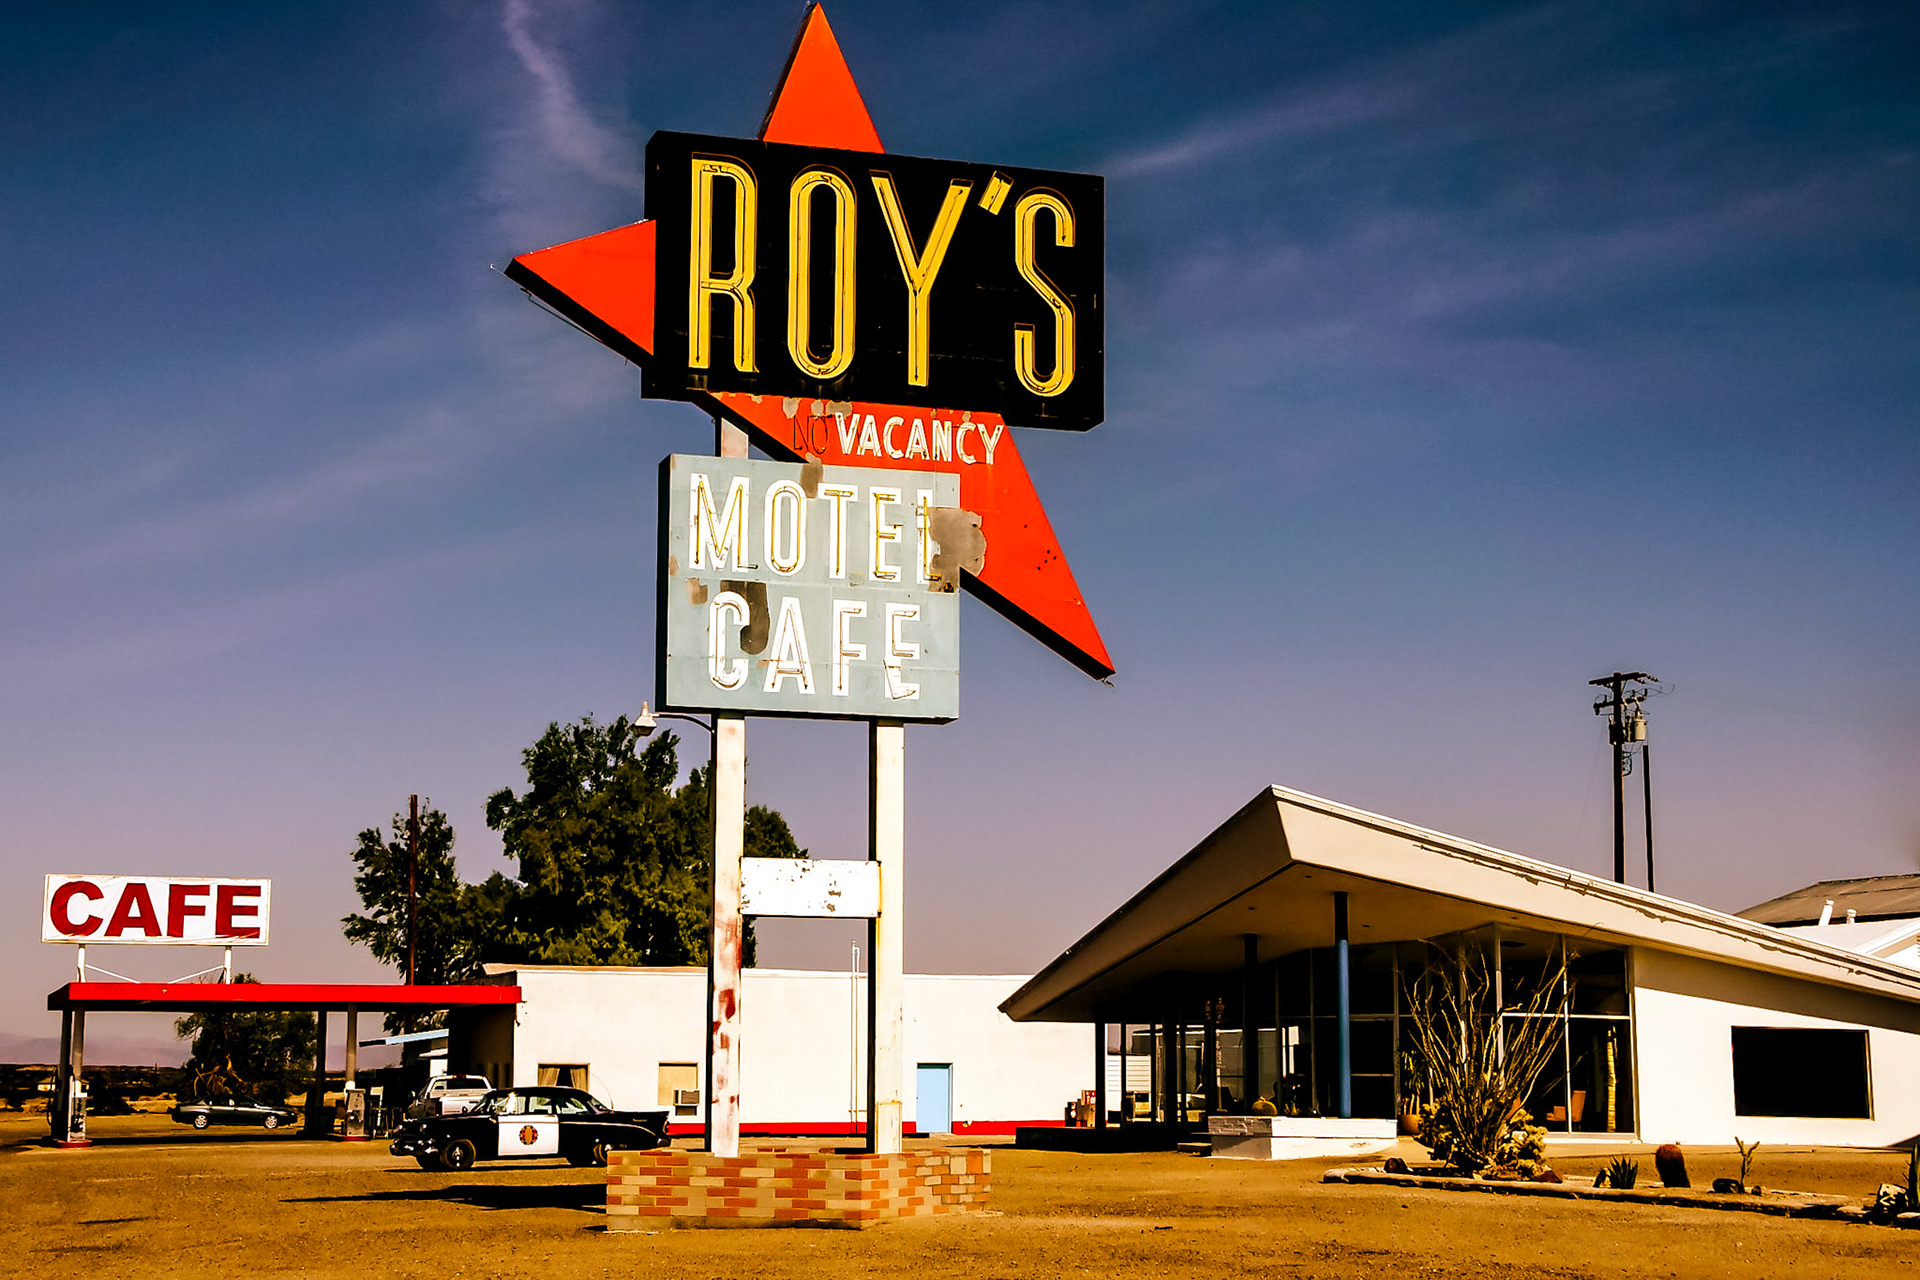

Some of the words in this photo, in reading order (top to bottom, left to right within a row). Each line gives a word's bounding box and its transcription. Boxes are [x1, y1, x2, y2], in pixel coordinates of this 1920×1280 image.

[689, 152, 1076, 397] ROY'S
[834, 412, 1004, 465] VACANCY
[689, 472, 942, 584] MOTEL
[706, 591, 921, 700] CAFE
[50, 880, 261, 938] CAFE
